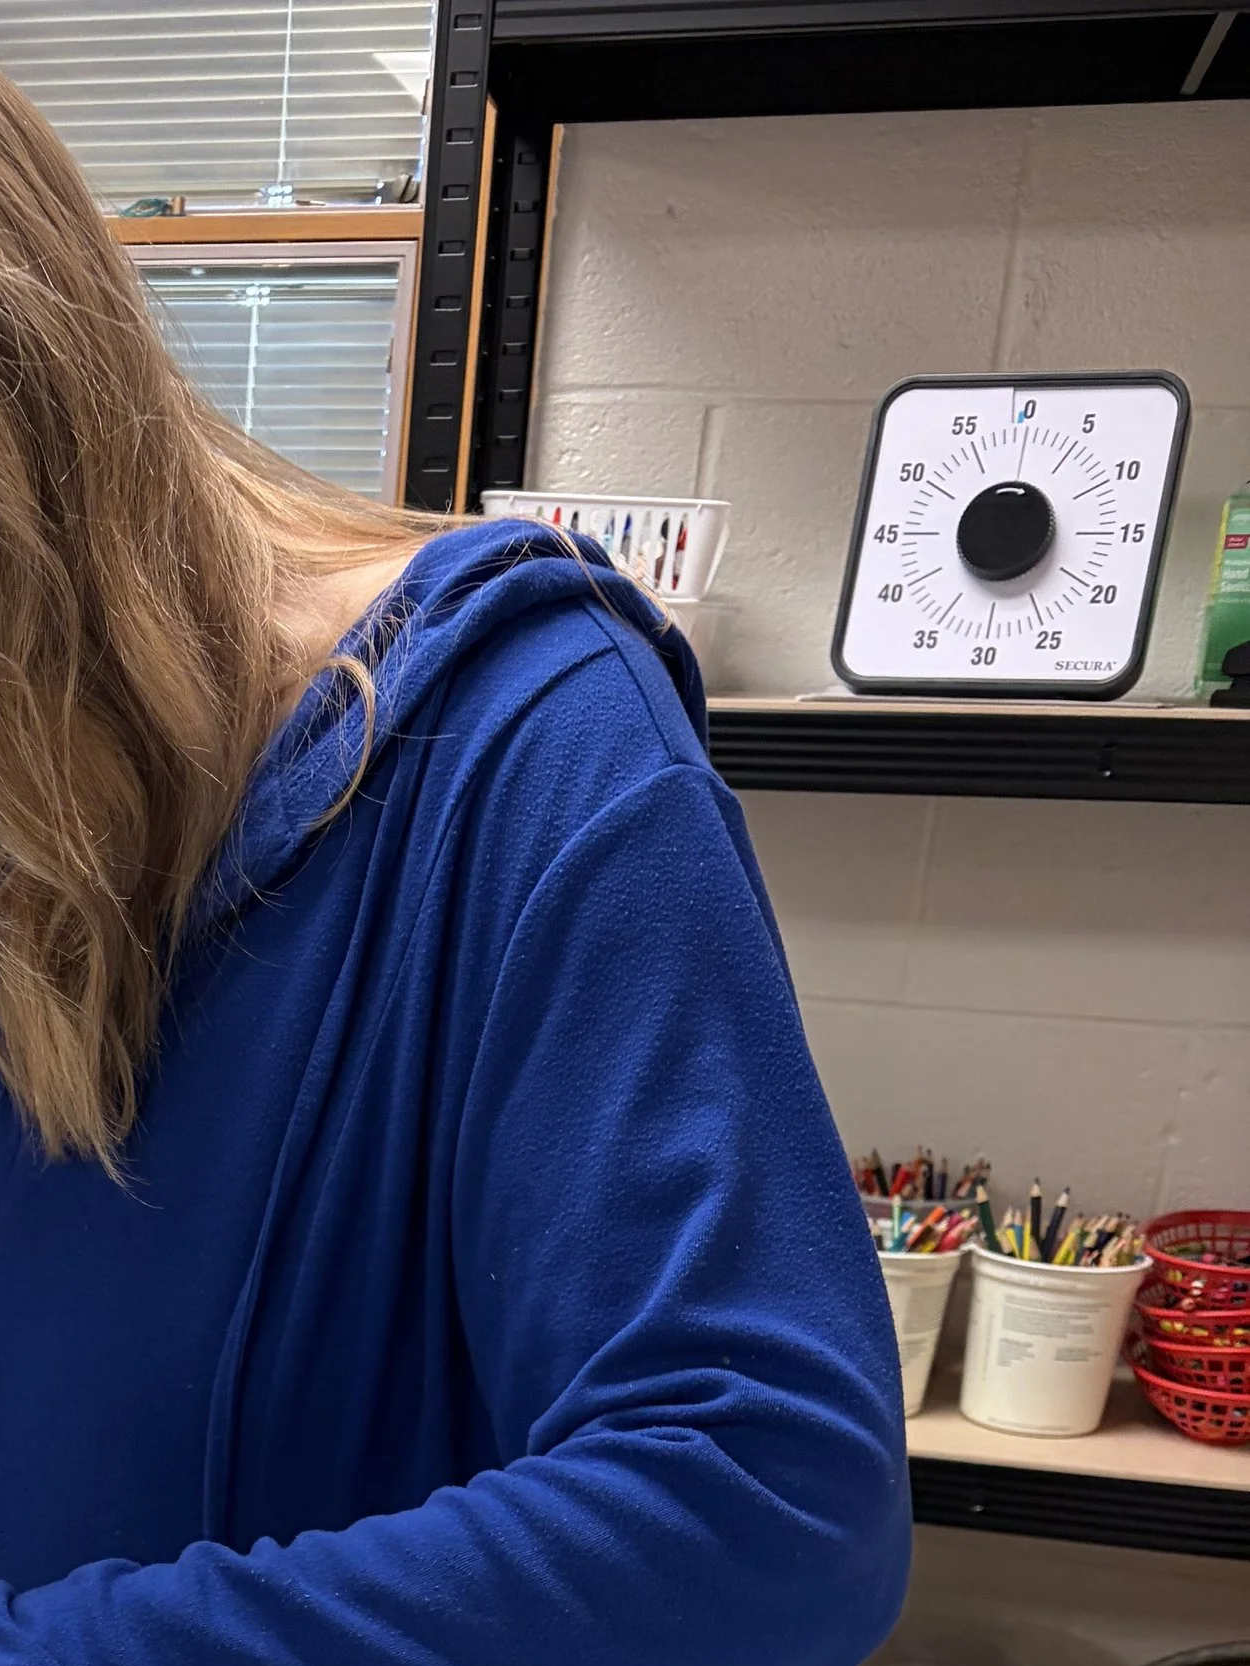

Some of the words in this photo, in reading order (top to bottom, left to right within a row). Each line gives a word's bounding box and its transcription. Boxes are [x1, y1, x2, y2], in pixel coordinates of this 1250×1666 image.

[1023, 400, 1036, 419] 0
[952, 416, 977, 435] 55
[1082, 414, 1095, 433] 5
[900, 463, 924, 481] 50
[1116, 461, 1140, 480] 10
[874, 525, 898, 543] 45
[1121, 524, 1145, 542] 15
[878, 584, 902, 602] 40
[1090, 585, 1116, 604] 20
[914, 631, 938, 648] 35
[1035, 631, 1062, 649] 25
[971, 647, 996, 665] 30
[1055, 660, 1113, 671] SECURA
